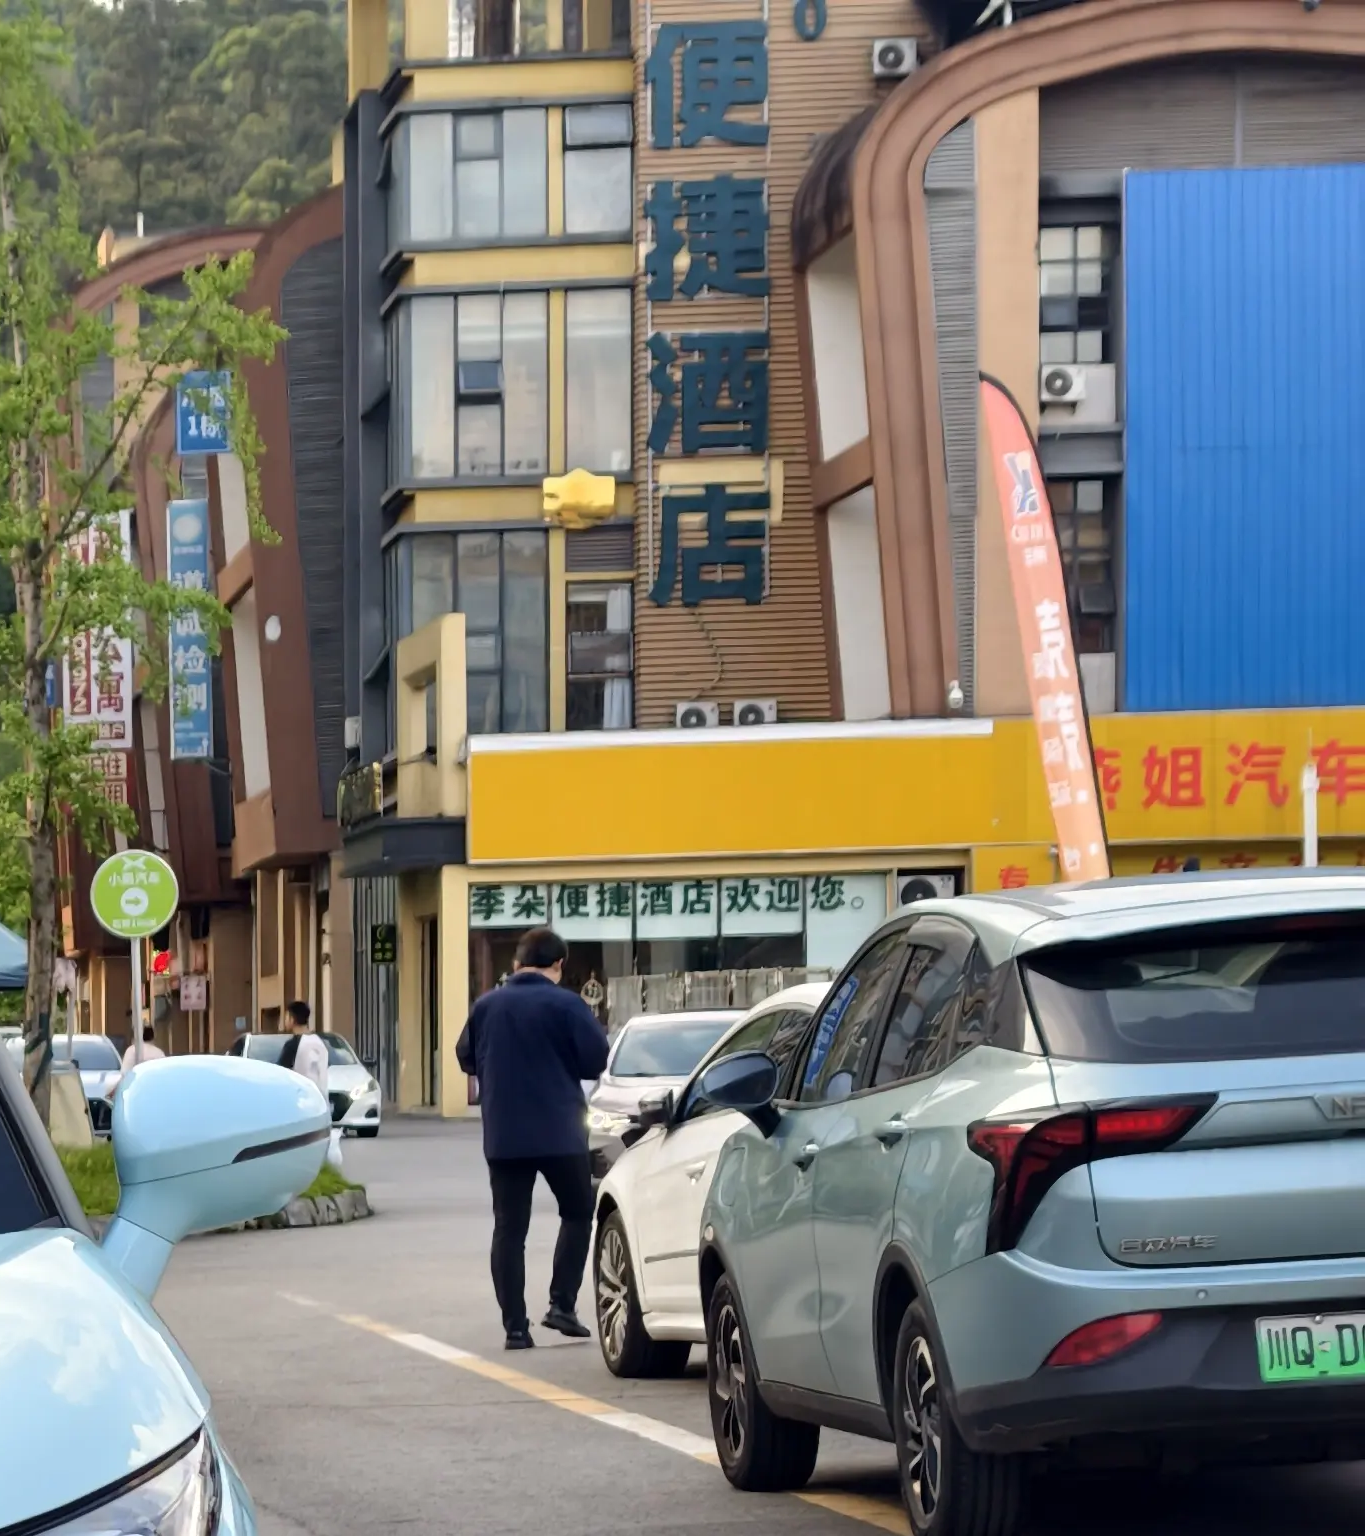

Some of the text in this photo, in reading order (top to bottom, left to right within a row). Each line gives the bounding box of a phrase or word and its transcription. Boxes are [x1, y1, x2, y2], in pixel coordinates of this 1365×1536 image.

[644, 20, 770, 608] 便捷酒店
[1334, 1322, 1365, 1368] D
